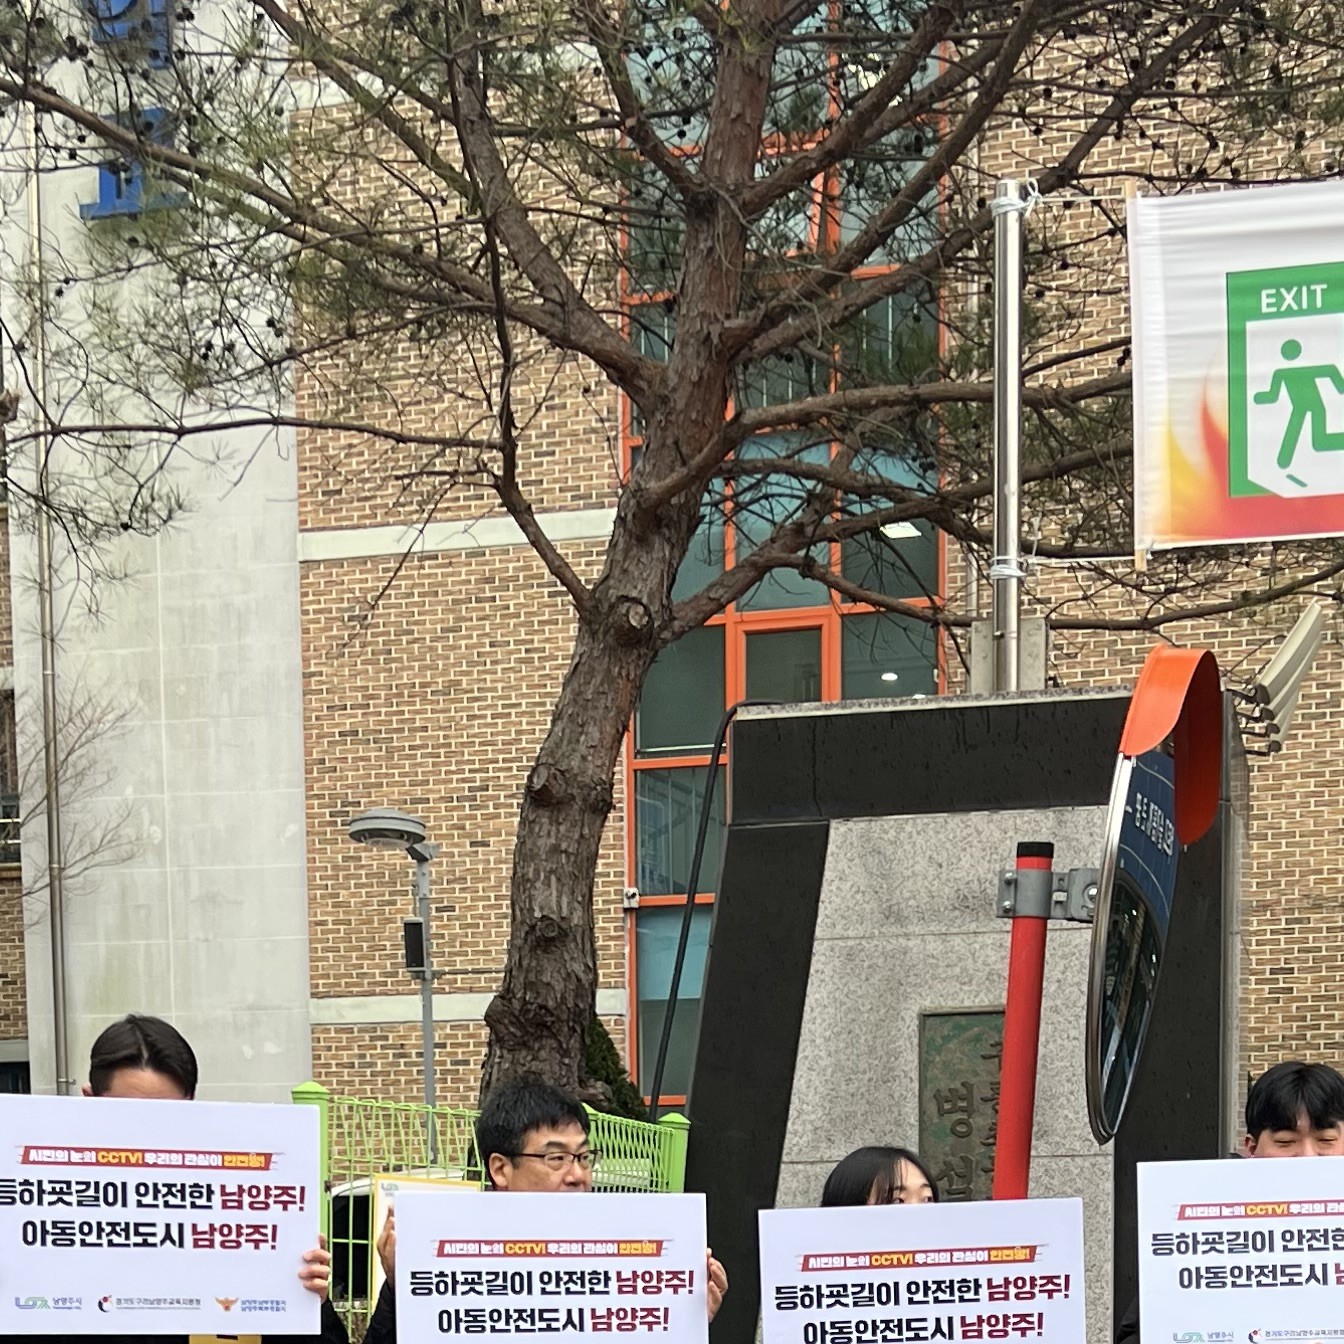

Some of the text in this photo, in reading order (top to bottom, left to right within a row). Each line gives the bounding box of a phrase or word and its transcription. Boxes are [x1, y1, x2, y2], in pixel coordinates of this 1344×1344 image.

[1259, 283, 1328, 314] EXIT
[97, 1150, 142, 1164] CCTV!
[134, 1181, 214, 1209] 안전한
[219, 1183, 305, 1211] 남양주!
[1246, 1203, 1287, 1215] CCTV!
[21, 1219, 277, 1249] 아동안전도시 남양주!
[1151, 1229, 1274, 1255] 등하굣길이
[505, 1242, 545, 1254] CCTV!
[871, 1253, 913, 1266] CCTV!
[409, 1270, 694, 1295] 등하굣길이 안전한 남양주!
[1178, 1262, 1327, 1289] 아동안전도시
[774, 1274, 1070, 1309] 등하굣길이 안전한 남양주!
[437, 1307, 669, 1333] 아동안전도시 남양주!
[803, 1312, 1043, 1344] 아동안전도시 남양주!
